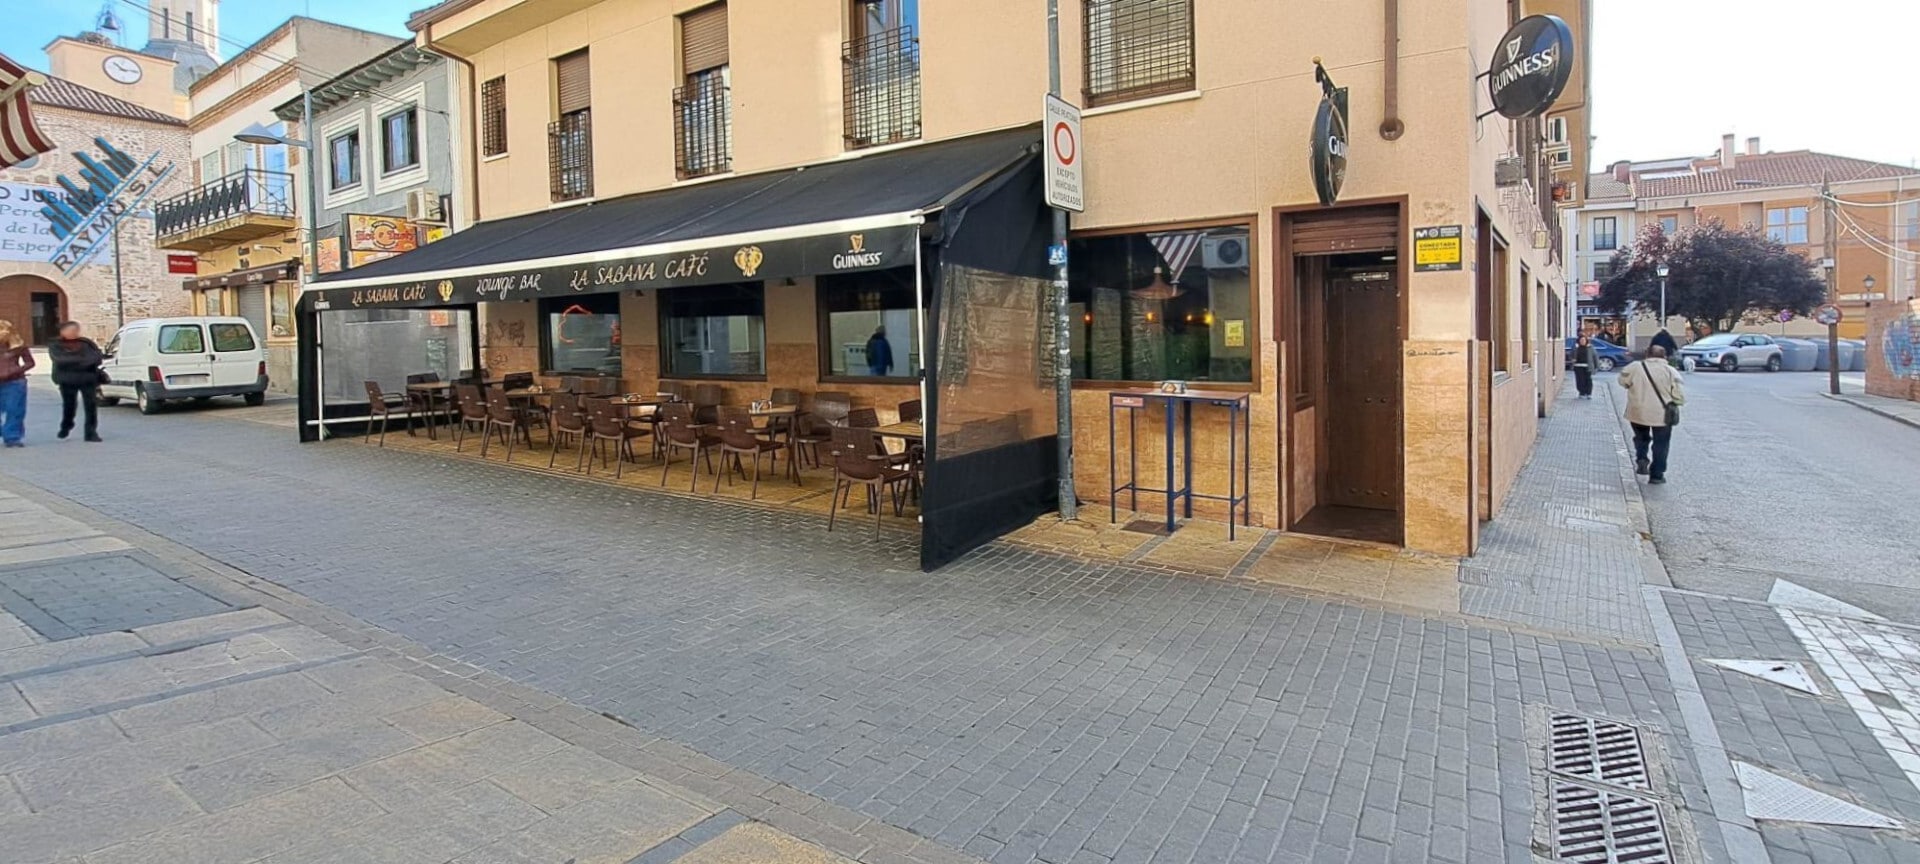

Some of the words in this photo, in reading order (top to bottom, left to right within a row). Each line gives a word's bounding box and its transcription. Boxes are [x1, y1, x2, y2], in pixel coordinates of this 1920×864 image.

[1492, 49, 1553, 95] GUINNESS
[5, 221, 28, 234] de
[570, 270, 589, 291] LA
[595, 261, 657, 285] SABANA
[664, 252, 709, 279] CAFÉ
[833, 252, 883, 270] GUINNESS
[352, 291, 362, 307] LA
[366, 288, 399, 304] SABANA
[476, 275, 516, 300] LOUNGE
[519, 273, 542, 291] BAR
